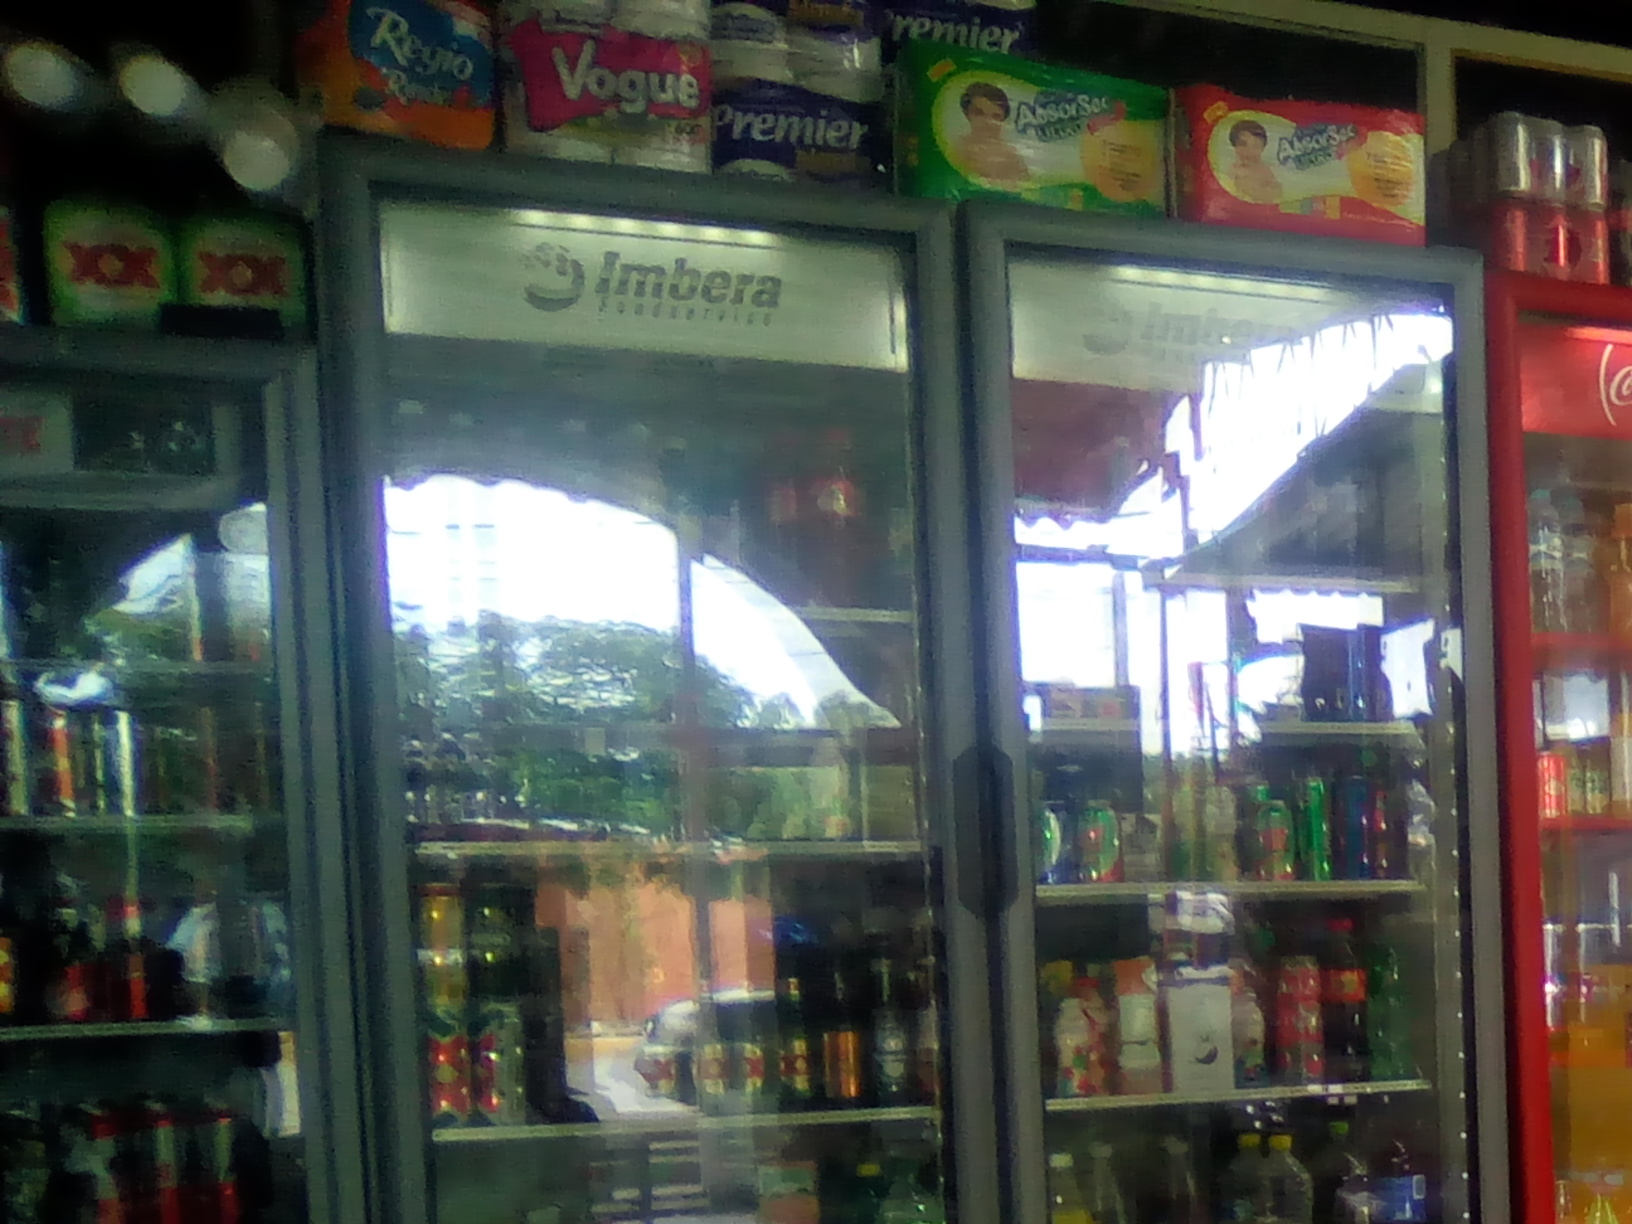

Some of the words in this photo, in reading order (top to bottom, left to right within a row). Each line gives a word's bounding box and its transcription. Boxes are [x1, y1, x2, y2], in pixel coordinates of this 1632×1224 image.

[365, 6, 474, 81] Regio
[885, 9, 1021, 55] remier
[552, 38, 699, 114] Vogue
[714, 104, 868, 149] Premier
[596, 251, 782, 308] Imbera
